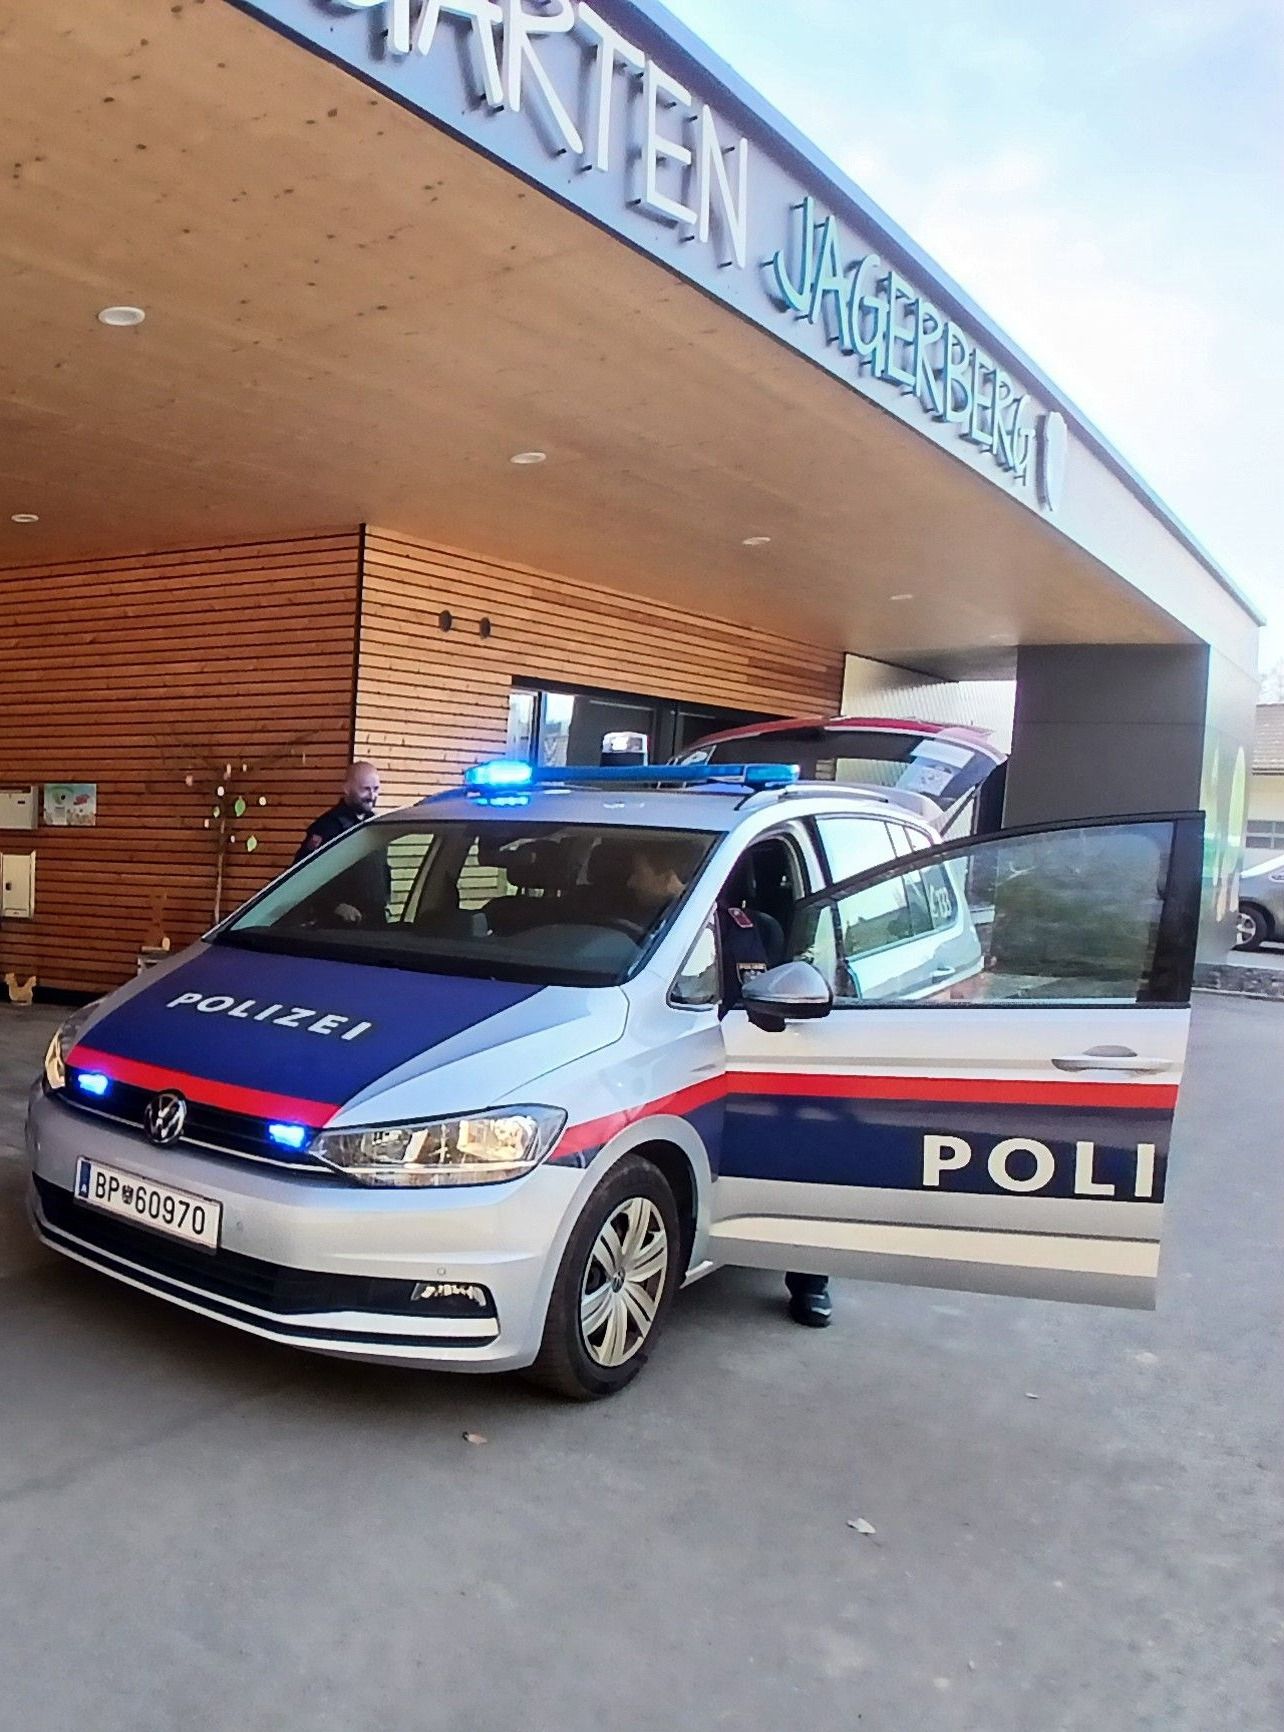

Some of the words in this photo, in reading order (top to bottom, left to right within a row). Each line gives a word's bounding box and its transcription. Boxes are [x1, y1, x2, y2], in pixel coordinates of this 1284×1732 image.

[773, 195, 1035, 486] JAGERBERG
[166, 992, 372, 1041] POLIZEI
[922, 1134, 1155, 1198] POLI
[95, 1171, 120, 1203] BP
[135, 1186, 206, 1235] 60970
